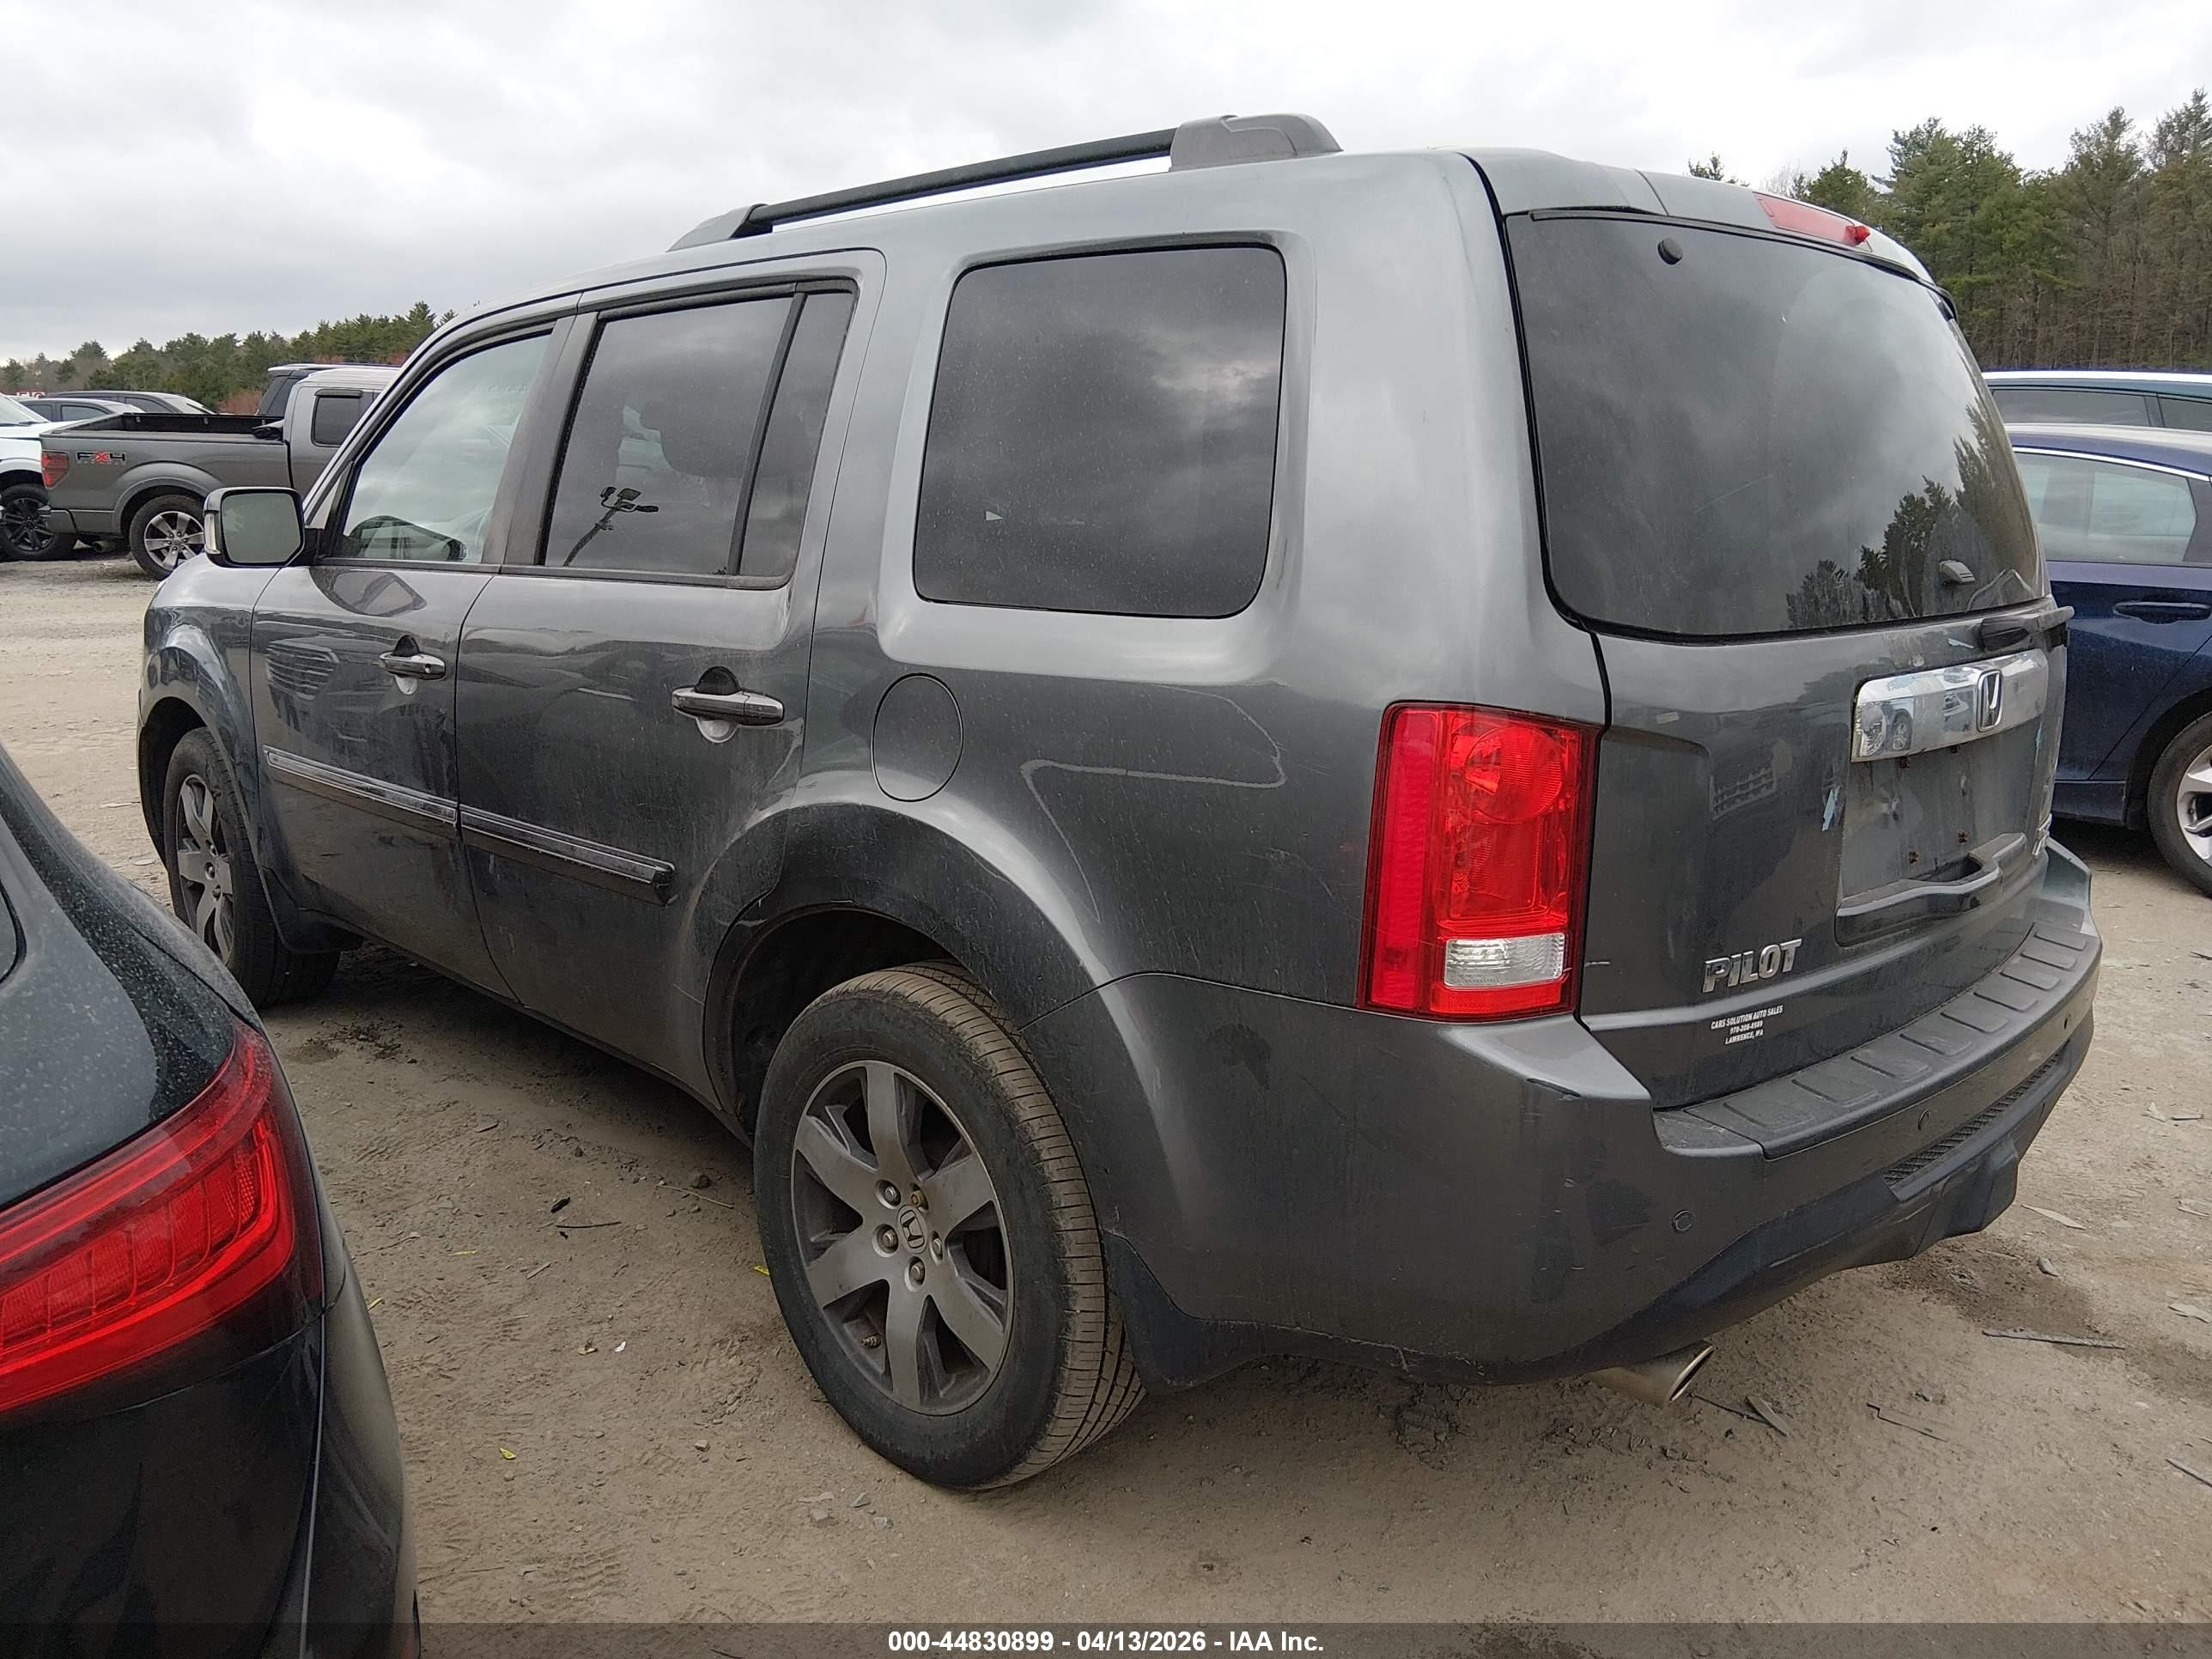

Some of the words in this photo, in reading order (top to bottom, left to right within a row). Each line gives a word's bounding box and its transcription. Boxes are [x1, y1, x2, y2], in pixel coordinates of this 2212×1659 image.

[76, 451, 126, 462] FX4
[1702, 938, 1802, 994] PILOT
[1711, 1018, 1726, 1030] CARS
[1726, 1013, 1753, 1027] SOLUTION
[1753, 1009, 1767, 1019] AUTO
[1767, 1005, 1784, 1017] SALES
